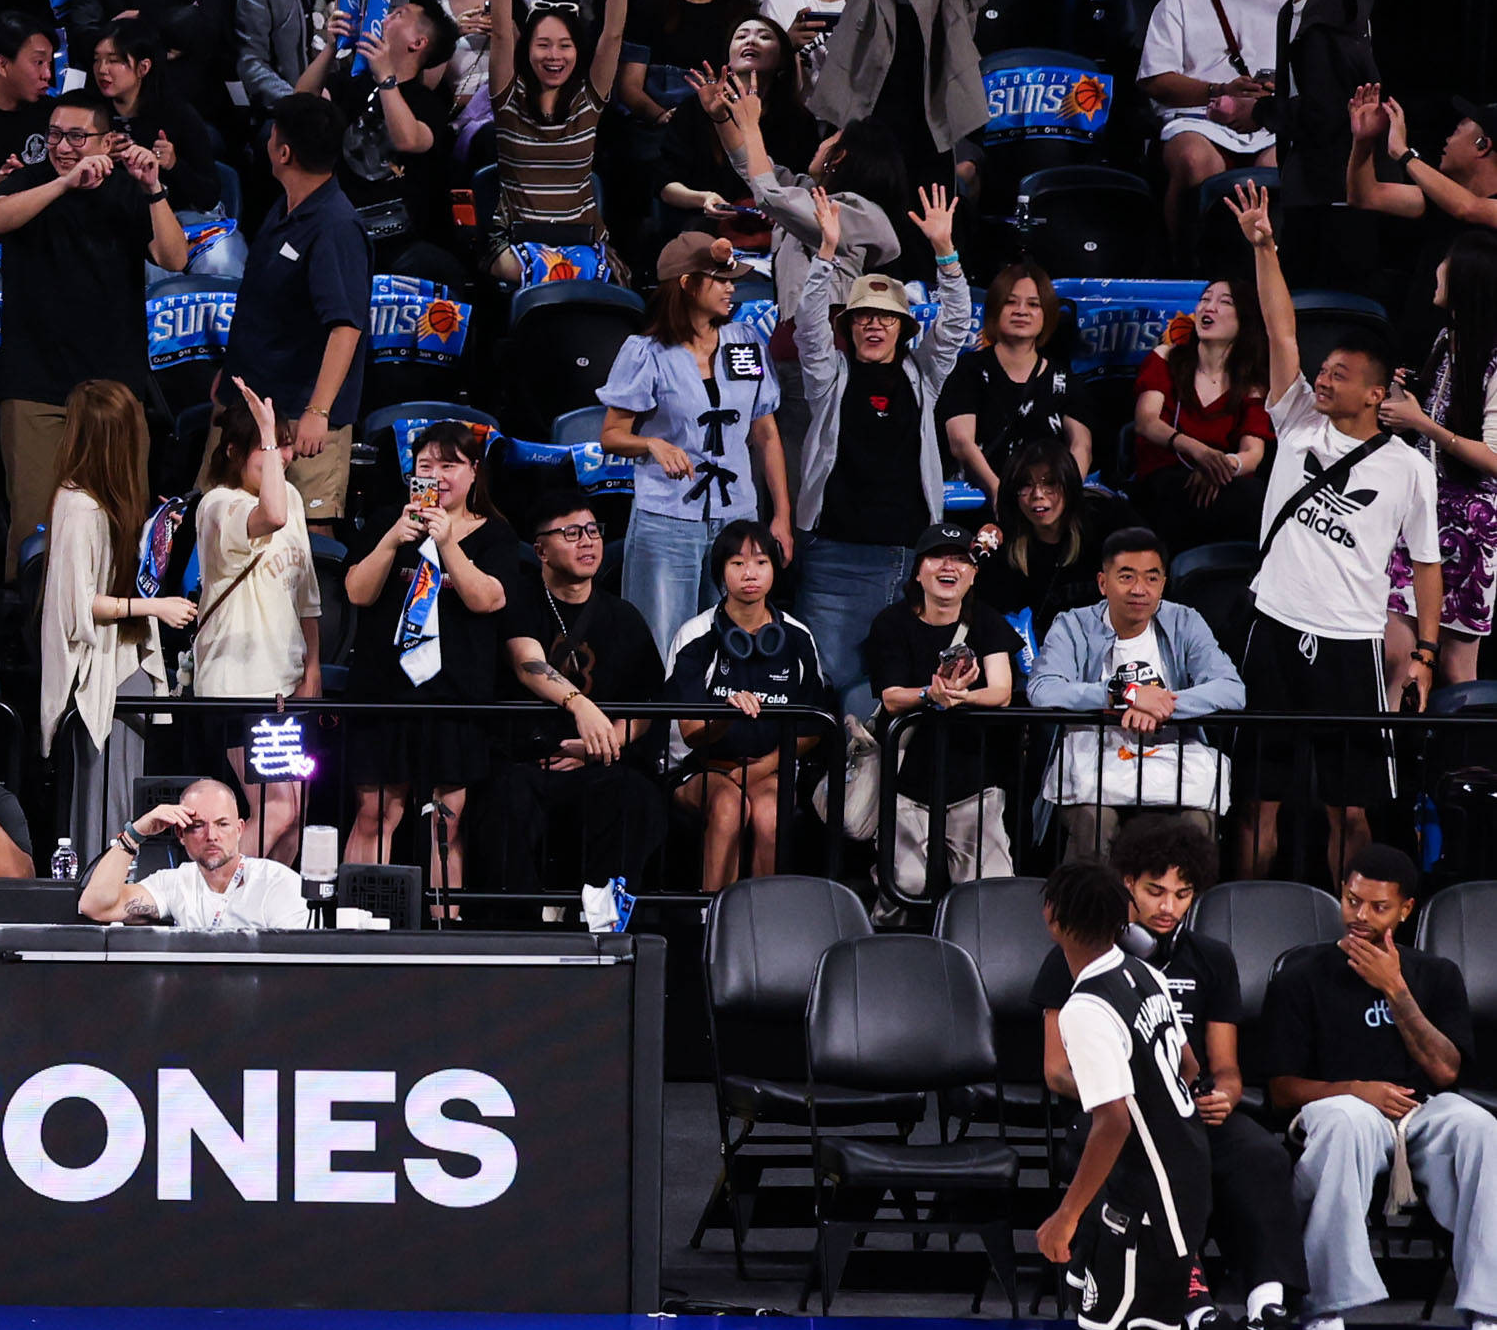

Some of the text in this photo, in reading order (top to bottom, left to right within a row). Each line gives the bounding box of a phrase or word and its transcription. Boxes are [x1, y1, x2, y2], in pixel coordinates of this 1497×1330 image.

[987, 83, 1067, 119] SUNS
[152, 302, 237, 342] SUNS
[1295, 505, 1357, 550] didas
[767, 692, 789, 705] club
